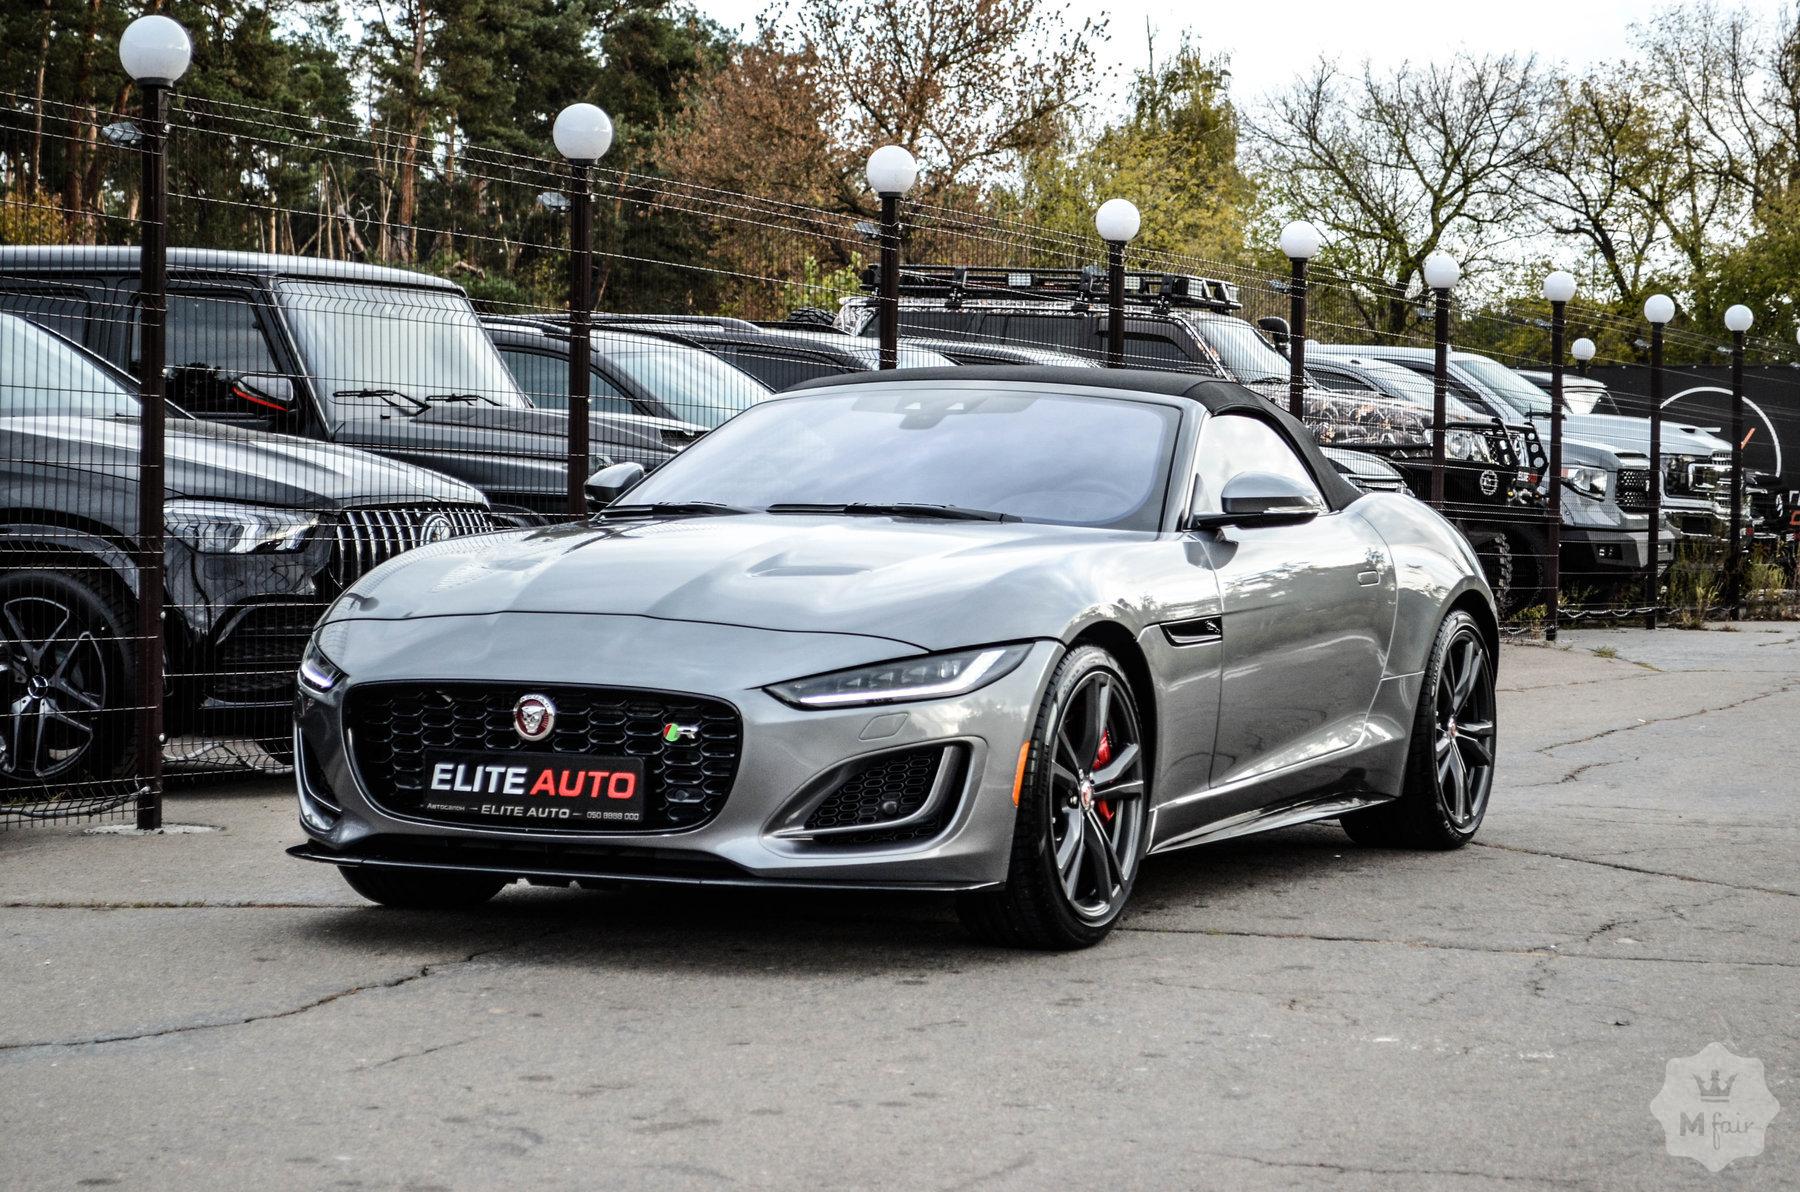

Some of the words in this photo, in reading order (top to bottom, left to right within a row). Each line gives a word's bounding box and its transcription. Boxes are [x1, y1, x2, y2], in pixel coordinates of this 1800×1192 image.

[431, 763, 527, 794] ELITE
[530, 769, 635, 799] AUTO
[481, 804, 524, 816] ELITE
[527, 808, 570, 818] AUTO
